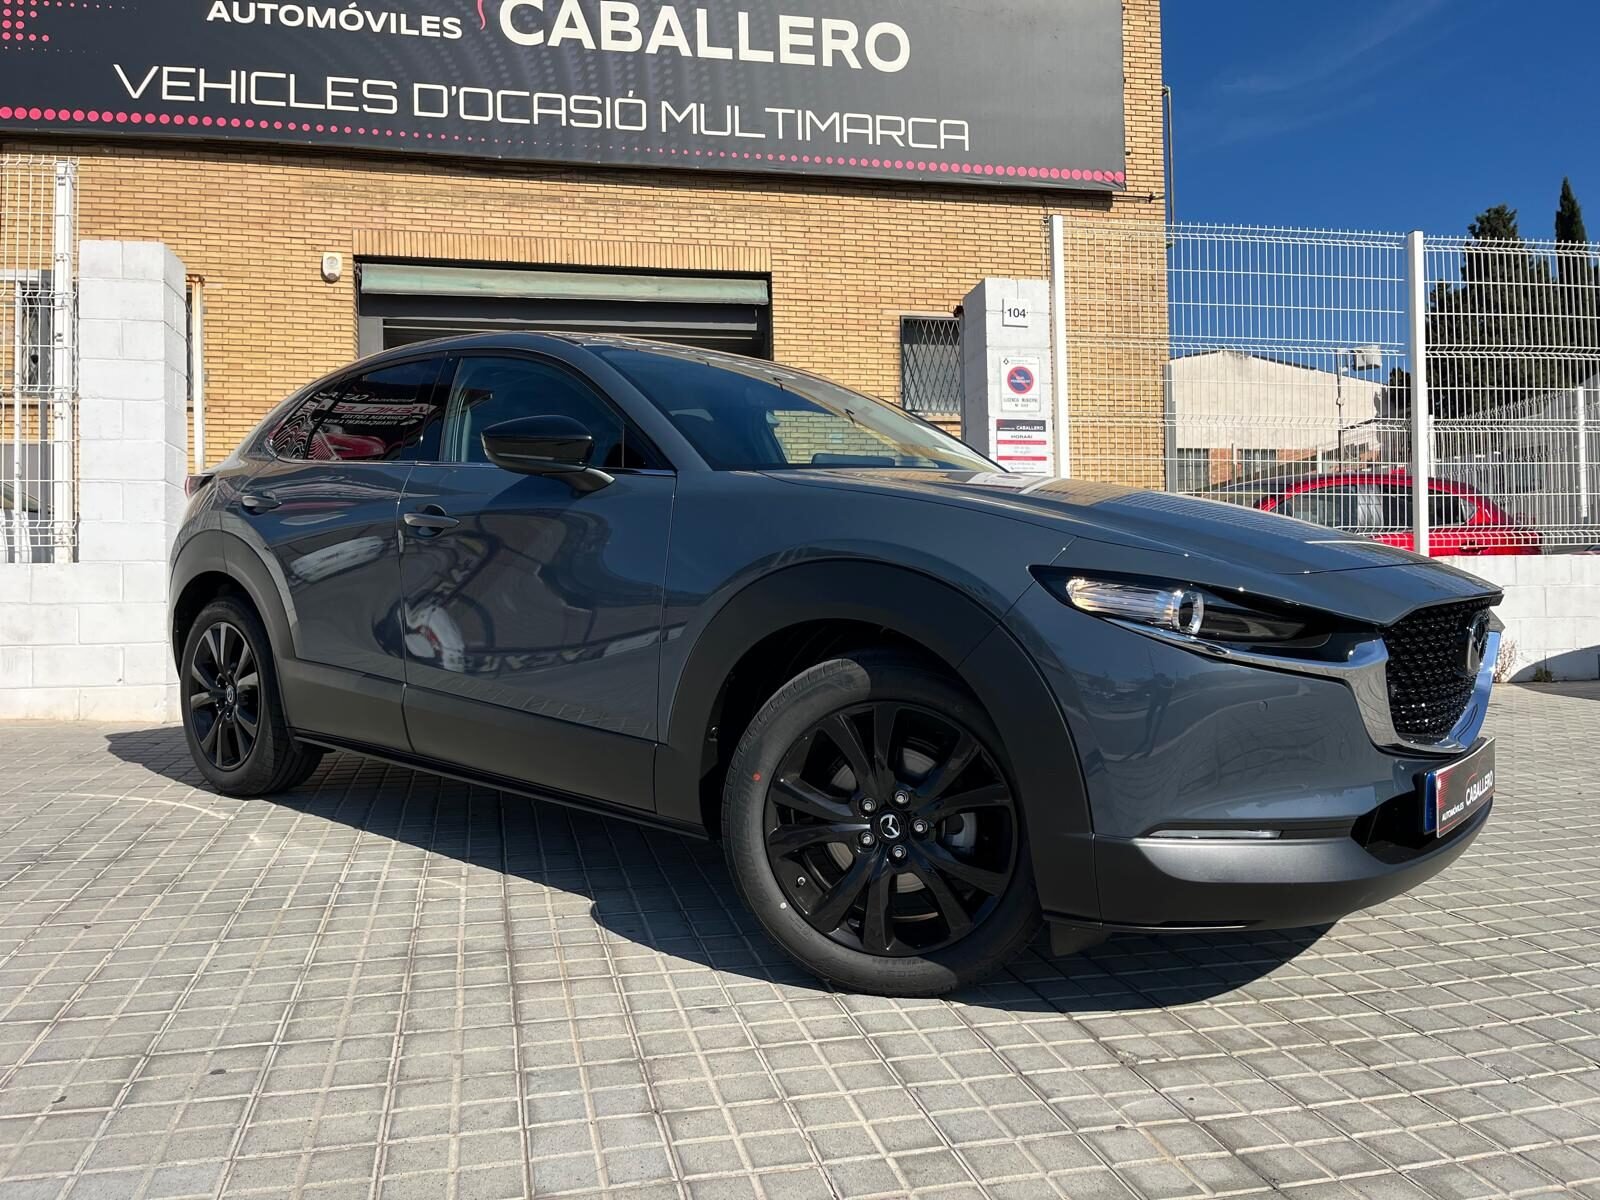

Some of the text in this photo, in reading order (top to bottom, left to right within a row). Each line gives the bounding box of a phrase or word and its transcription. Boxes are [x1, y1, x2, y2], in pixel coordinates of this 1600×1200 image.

[206, 0, 911, 73] AUTOMÓVILES CABALLERO
[113, 64, 970, 152] VEHICLES D'OCASIÓ MULTIMARCA
[1007, 307, 1026, 318] 104
[1466, 770, 1493, 806] CABALLERO
